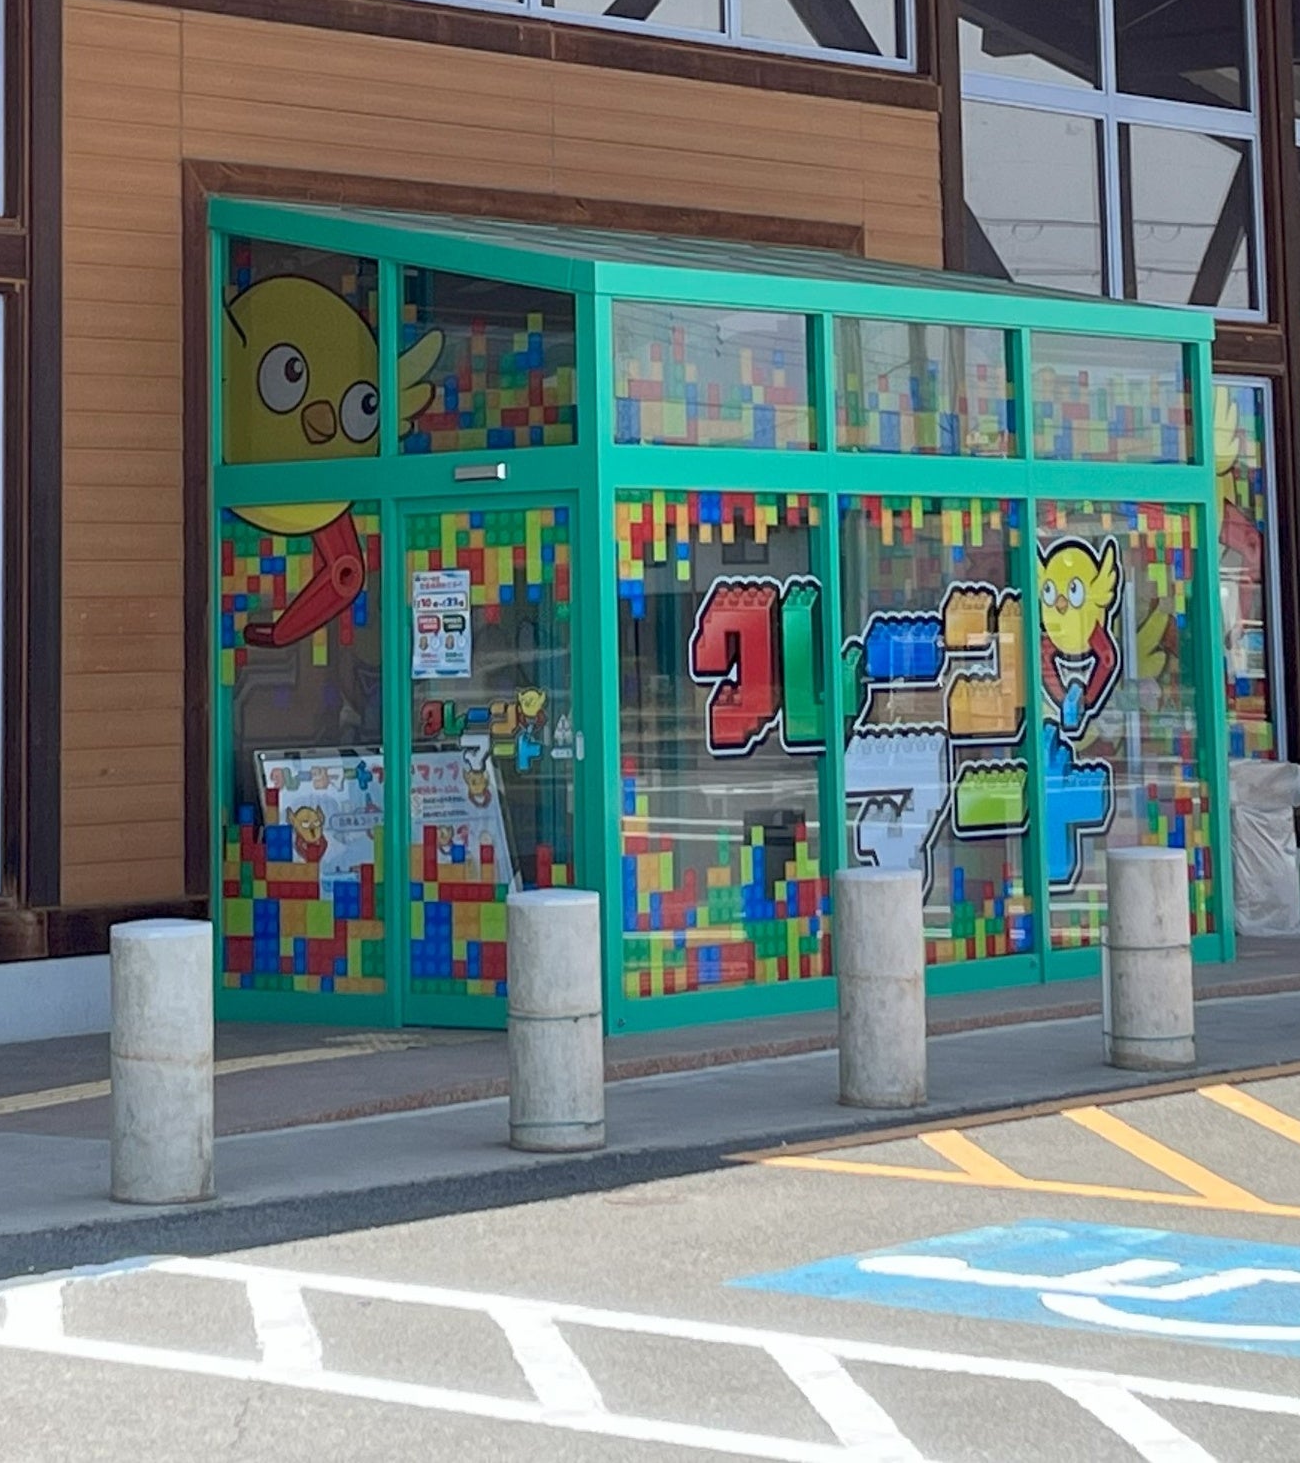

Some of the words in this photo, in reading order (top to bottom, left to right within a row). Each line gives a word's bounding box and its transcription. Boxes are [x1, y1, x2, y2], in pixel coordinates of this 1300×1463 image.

[419, 698, 518, 738] クレーン
[690, 576, 1028, 758] クレーン
[840, 718, 1116, 896] マート
